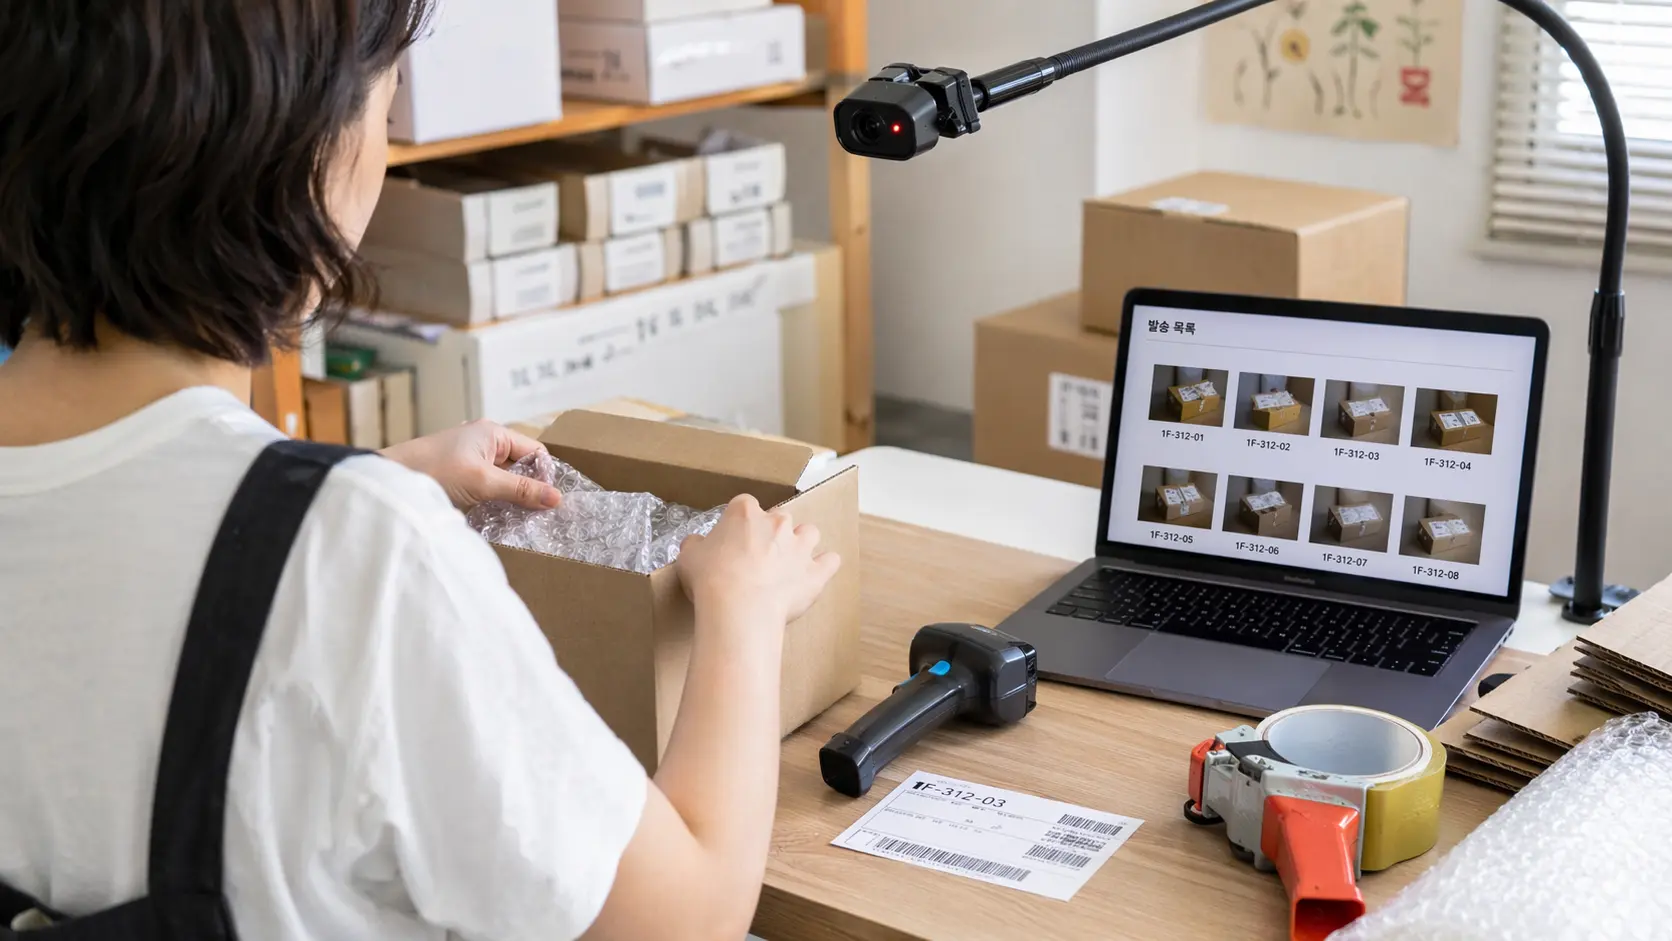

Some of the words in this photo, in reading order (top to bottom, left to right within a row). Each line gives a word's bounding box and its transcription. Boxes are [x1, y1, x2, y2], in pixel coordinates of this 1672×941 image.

[1147, 319, 1170, 334] 발송
[1173, 320, 1196, 336] 목록
[1161, 428, 1204, 442] 1F-312-01
[1246, 437, 1291, 452] 1F-312-02
[1334, 446, 1380, 461] 1F-312-03
[1424, 456, 1472, 471] 1F-312-04
[1150, 529, 1194, 544] 1F-312-05
[1235, 540, 1280, 556] 1F-312-06
[1322, 552, 1368, 567] 1F-312-07
[1412, 564, 1460, 580] 1F-312-08
[913, 780, 1007, 808] 1F-312-03
